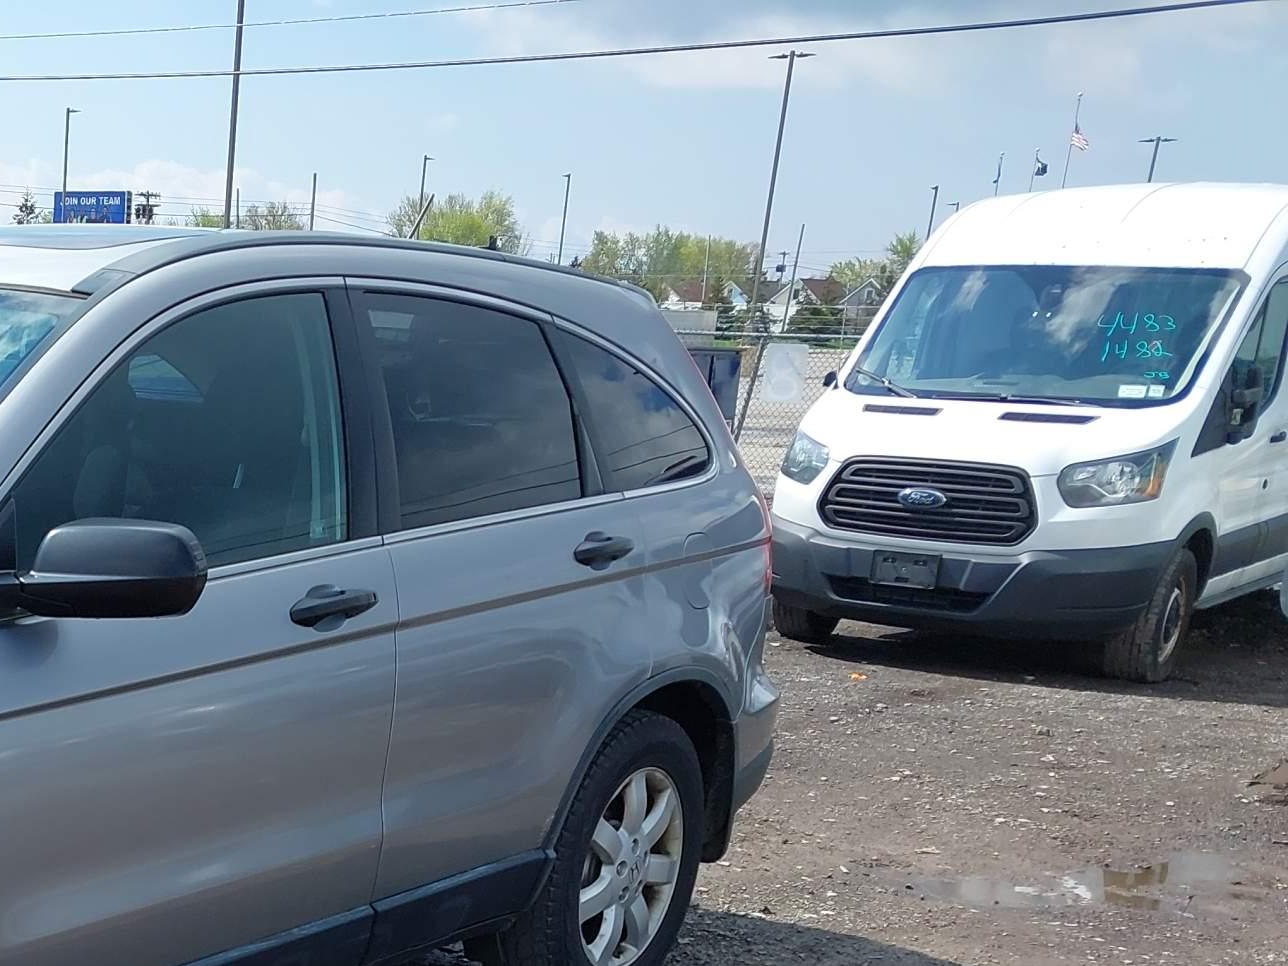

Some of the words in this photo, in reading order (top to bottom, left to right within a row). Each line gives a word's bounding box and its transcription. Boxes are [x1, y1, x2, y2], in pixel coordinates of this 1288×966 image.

[80, 196, 97, 206] OUR
[98, 196, 121, 206] TEAM
[1097, 311, 1176, 337] 4483
